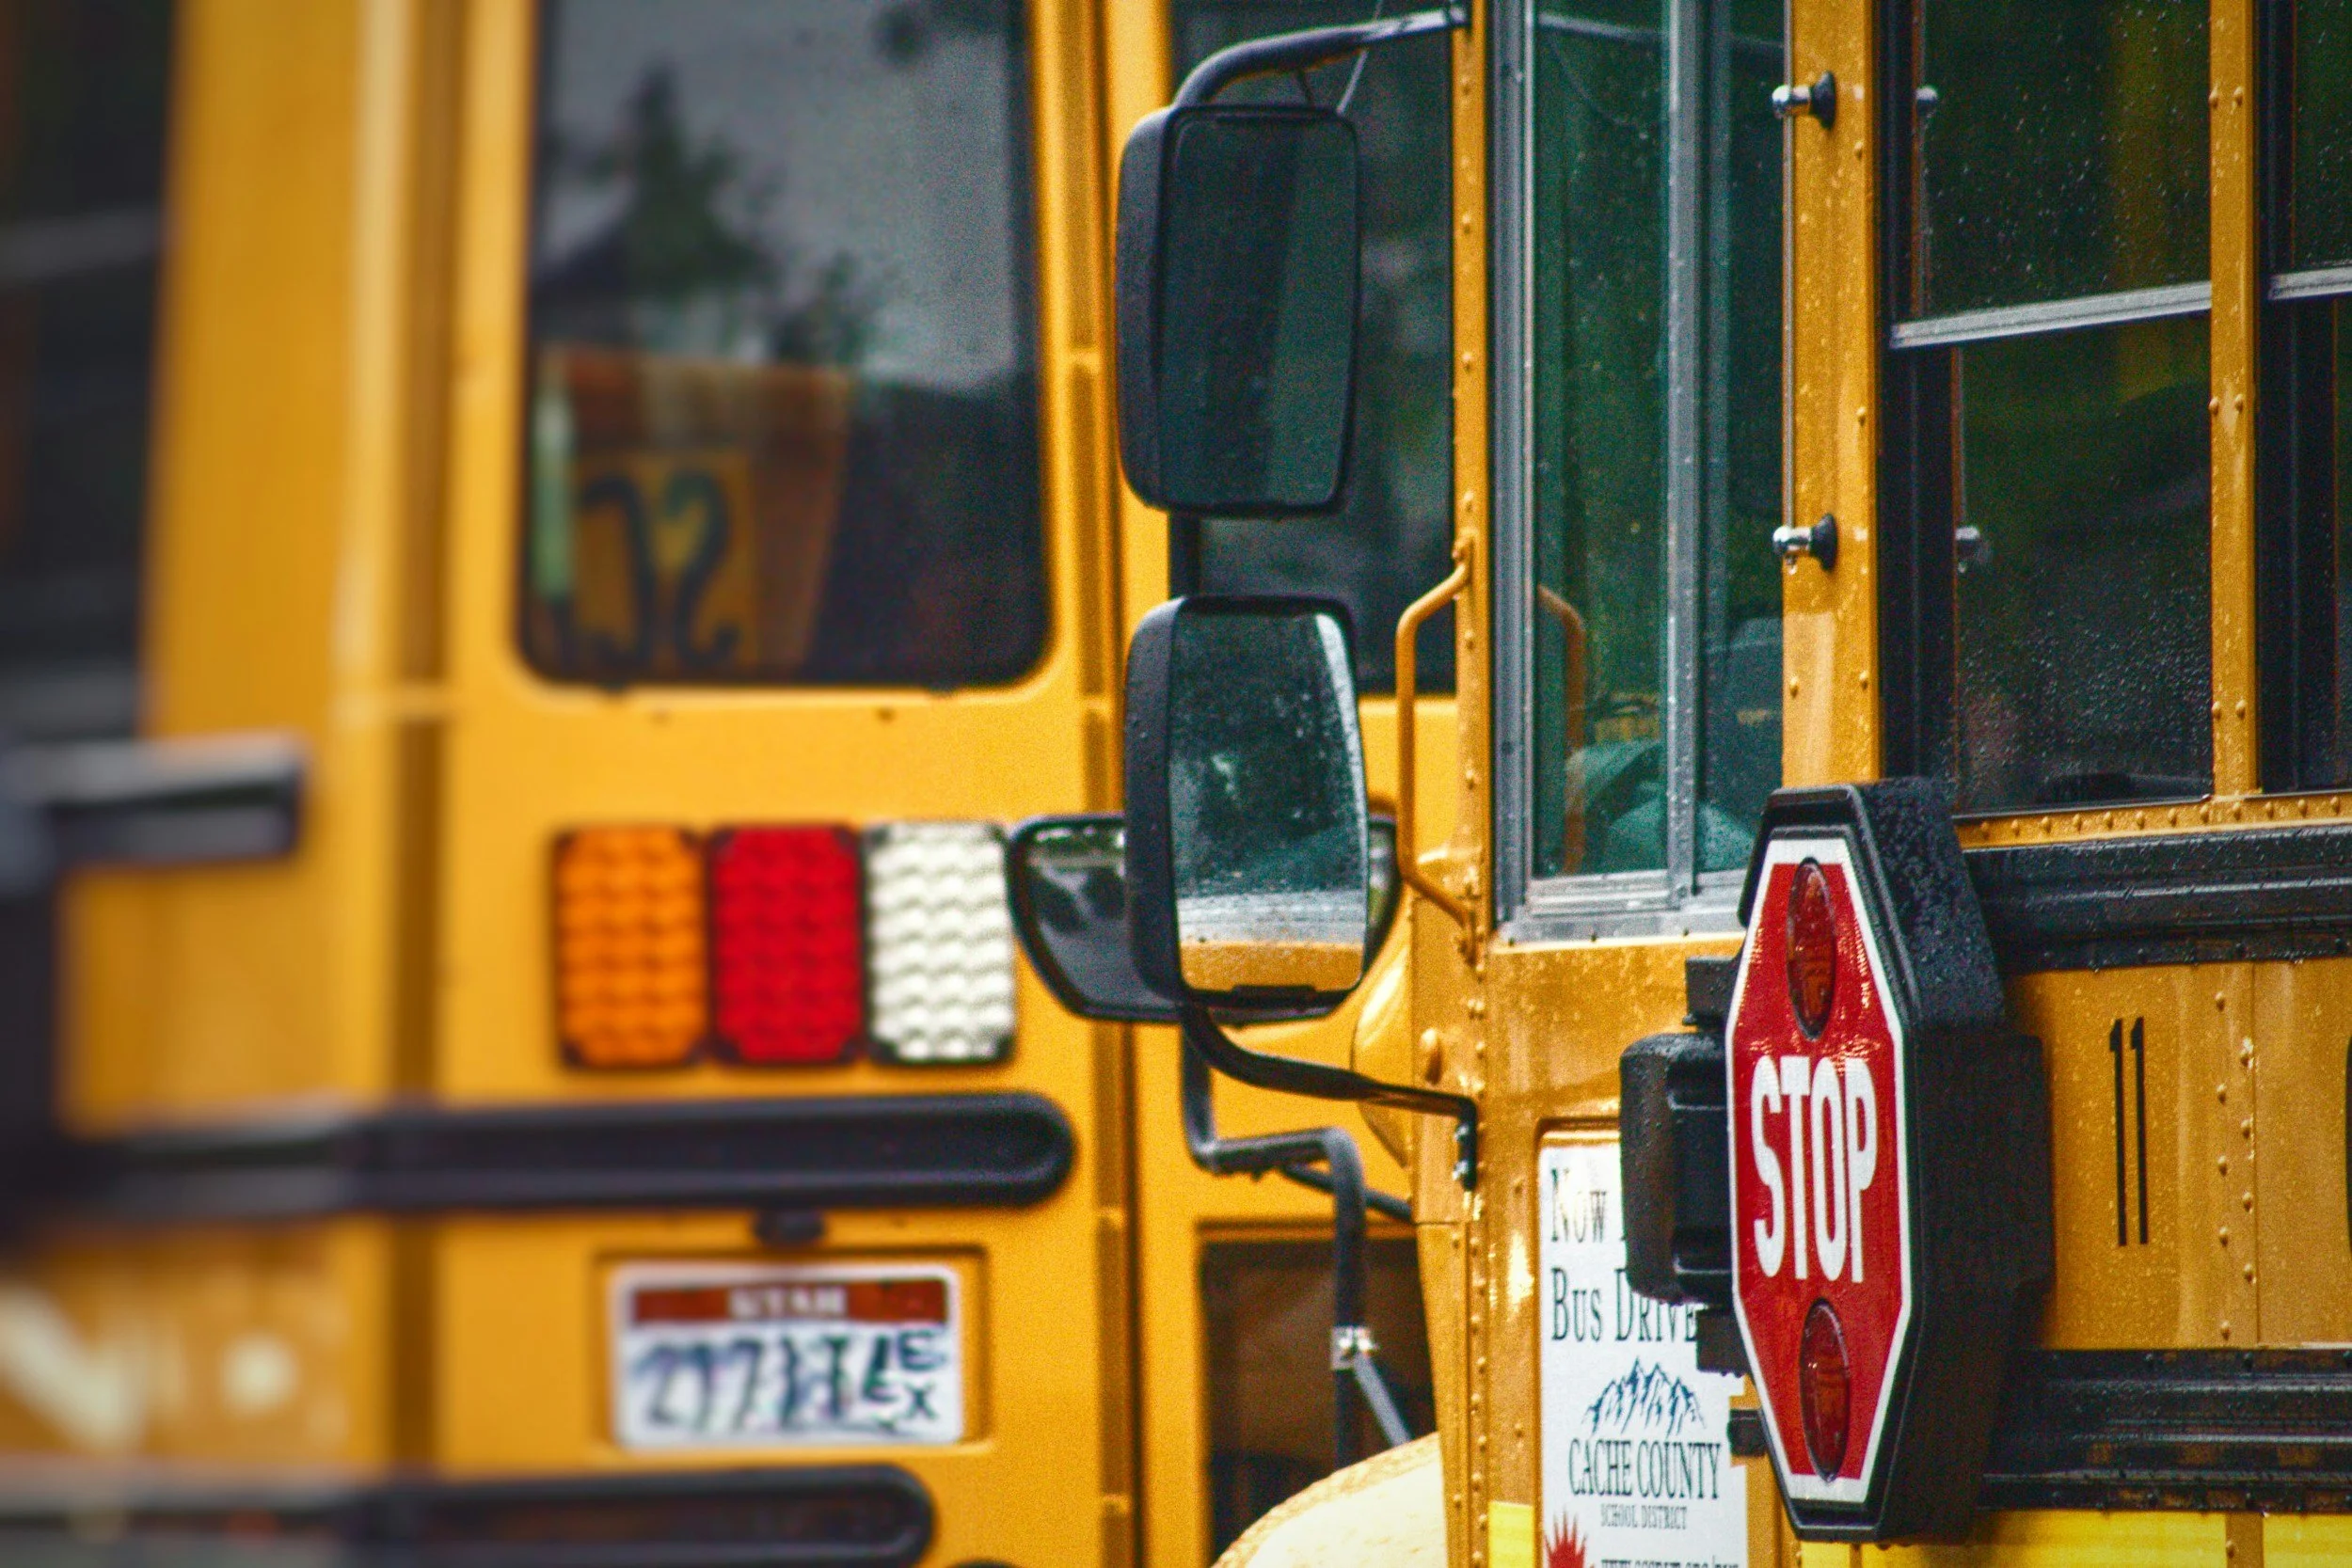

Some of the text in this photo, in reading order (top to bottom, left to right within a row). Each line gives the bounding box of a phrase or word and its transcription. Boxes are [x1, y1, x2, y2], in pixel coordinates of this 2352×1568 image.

[1751, 1054, 1878, 1283] STOP
[2108, 1016, 2149, 1246] 11
[1550, 1267, 1698, 1343] BUS DRIVE
[1568, 1438, 1722, 1499] CACHE COUNTY
[1600, 1504, 1688, 1530] SCHOOL DISTRICT
